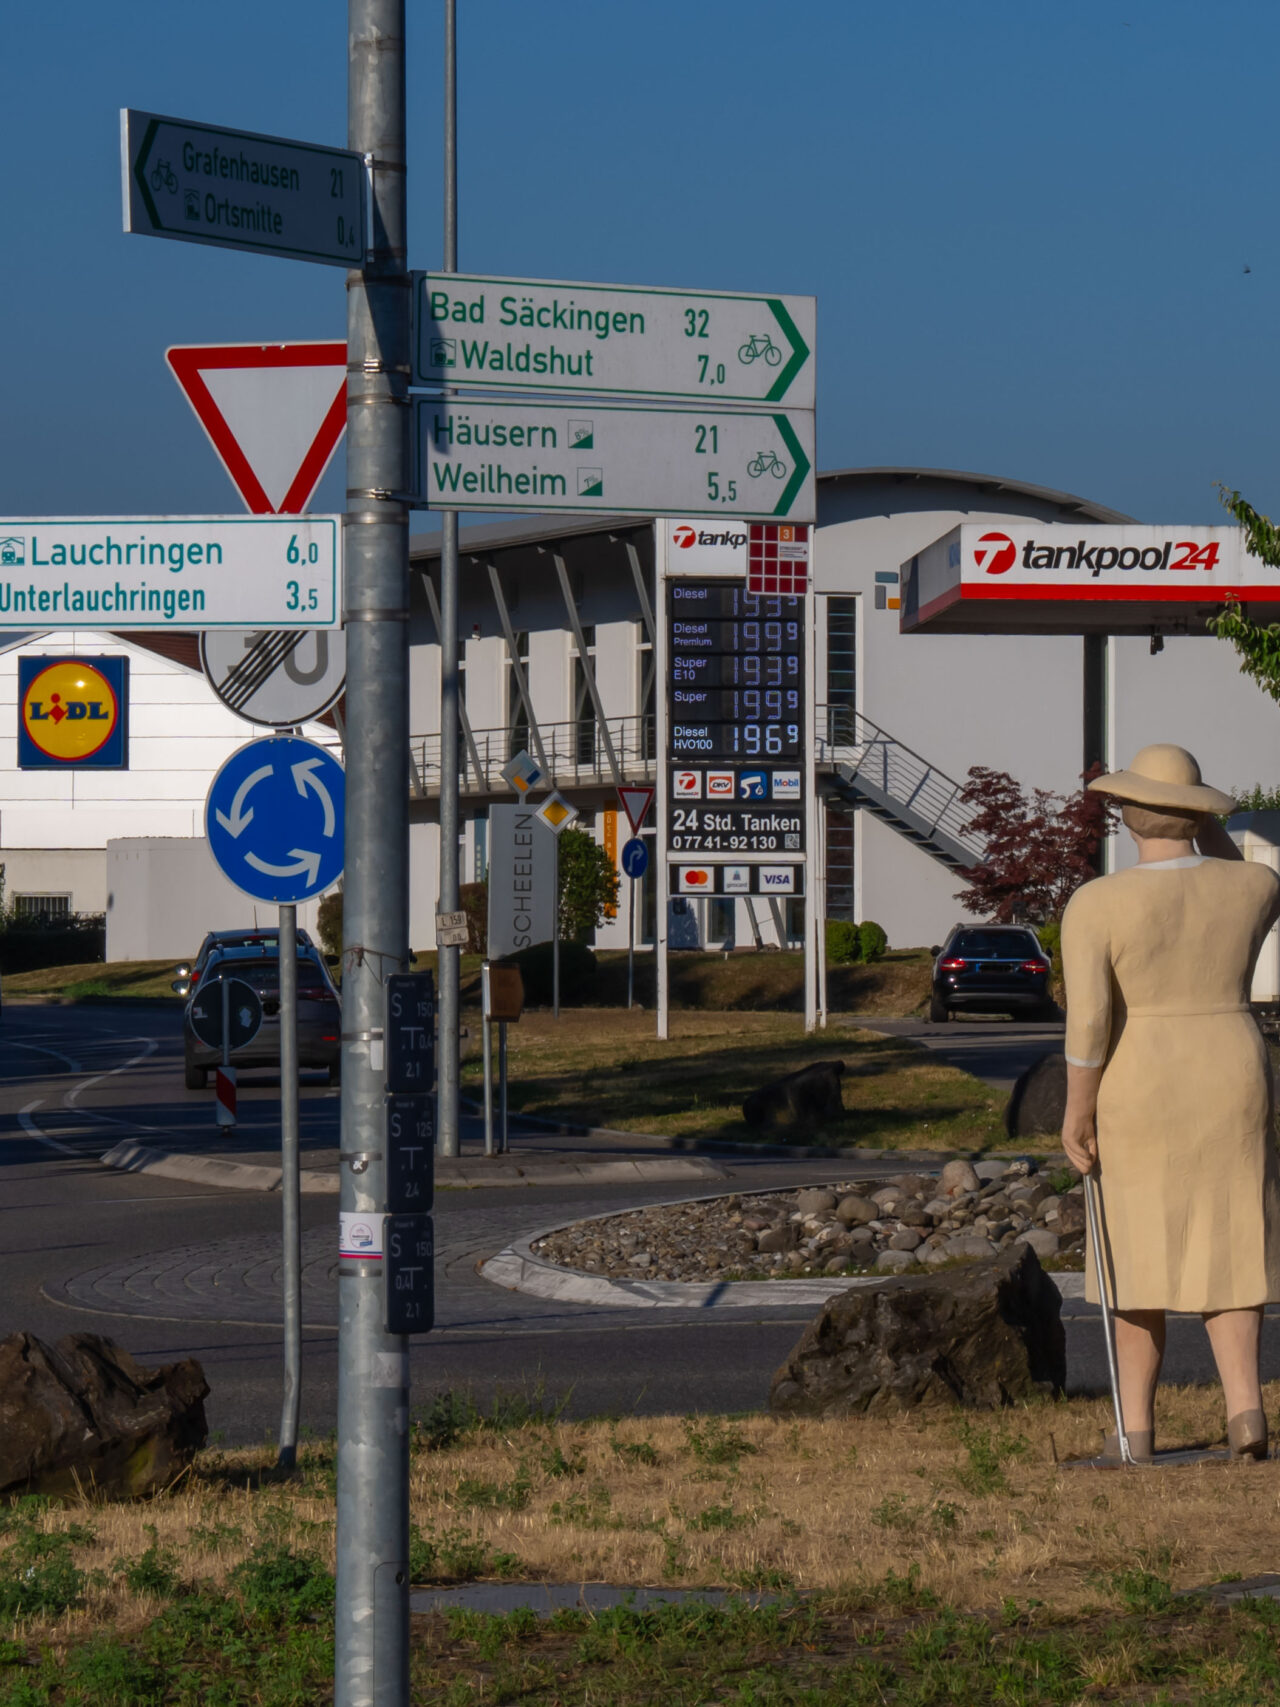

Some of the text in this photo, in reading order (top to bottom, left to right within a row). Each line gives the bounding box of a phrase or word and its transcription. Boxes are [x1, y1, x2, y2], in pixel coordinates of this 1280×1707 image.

[182, 141, 344, 199] Grafenhausen 21
[204, 192, 283, 235] Ortsmitte
[431, 291, 710, 339] Bad Säckingen 32
[461, 339, 726, 386] Waldshut 7,0
[433, 414, 558, 449] Häusern
[695, 425, 719, 454] 21
[433, 462, 567, 496] Weilheim
[707, 471, 738, 503] 5,5
[698, 531, 748, 549] tankp
[783, 529, 790, 540] 3
[31, 534, 319, 573] Lauchringen 6,0
[1022, 540, 1220, 577] tankpool24
[0, 580, 319, 619] Unterlauchringen 3,5
[673, 587, 708, 599] Diesel
[673, 622, 708, 634] Diesel
[673, 637, 712, 646] Premium
[674, 657, 708, 669] Super
[674, 670, 696, 681] E10
[674, 691, 708, 703] Super
[673, 726, 708, 737] Diesel
[673, 739, 713, 750] HVO100
[774, 778, 800, 787] Mobil
[673, 809, 800, 832] 24 Std. Tanken
[513, 814, 533, 948] SCHEELEN
[763, 874, 790, 885] VISA
[391, 992, 402, 1017] S
[391, 1113, 401, 1137] S
[391, 1233, 401, 1258] S
